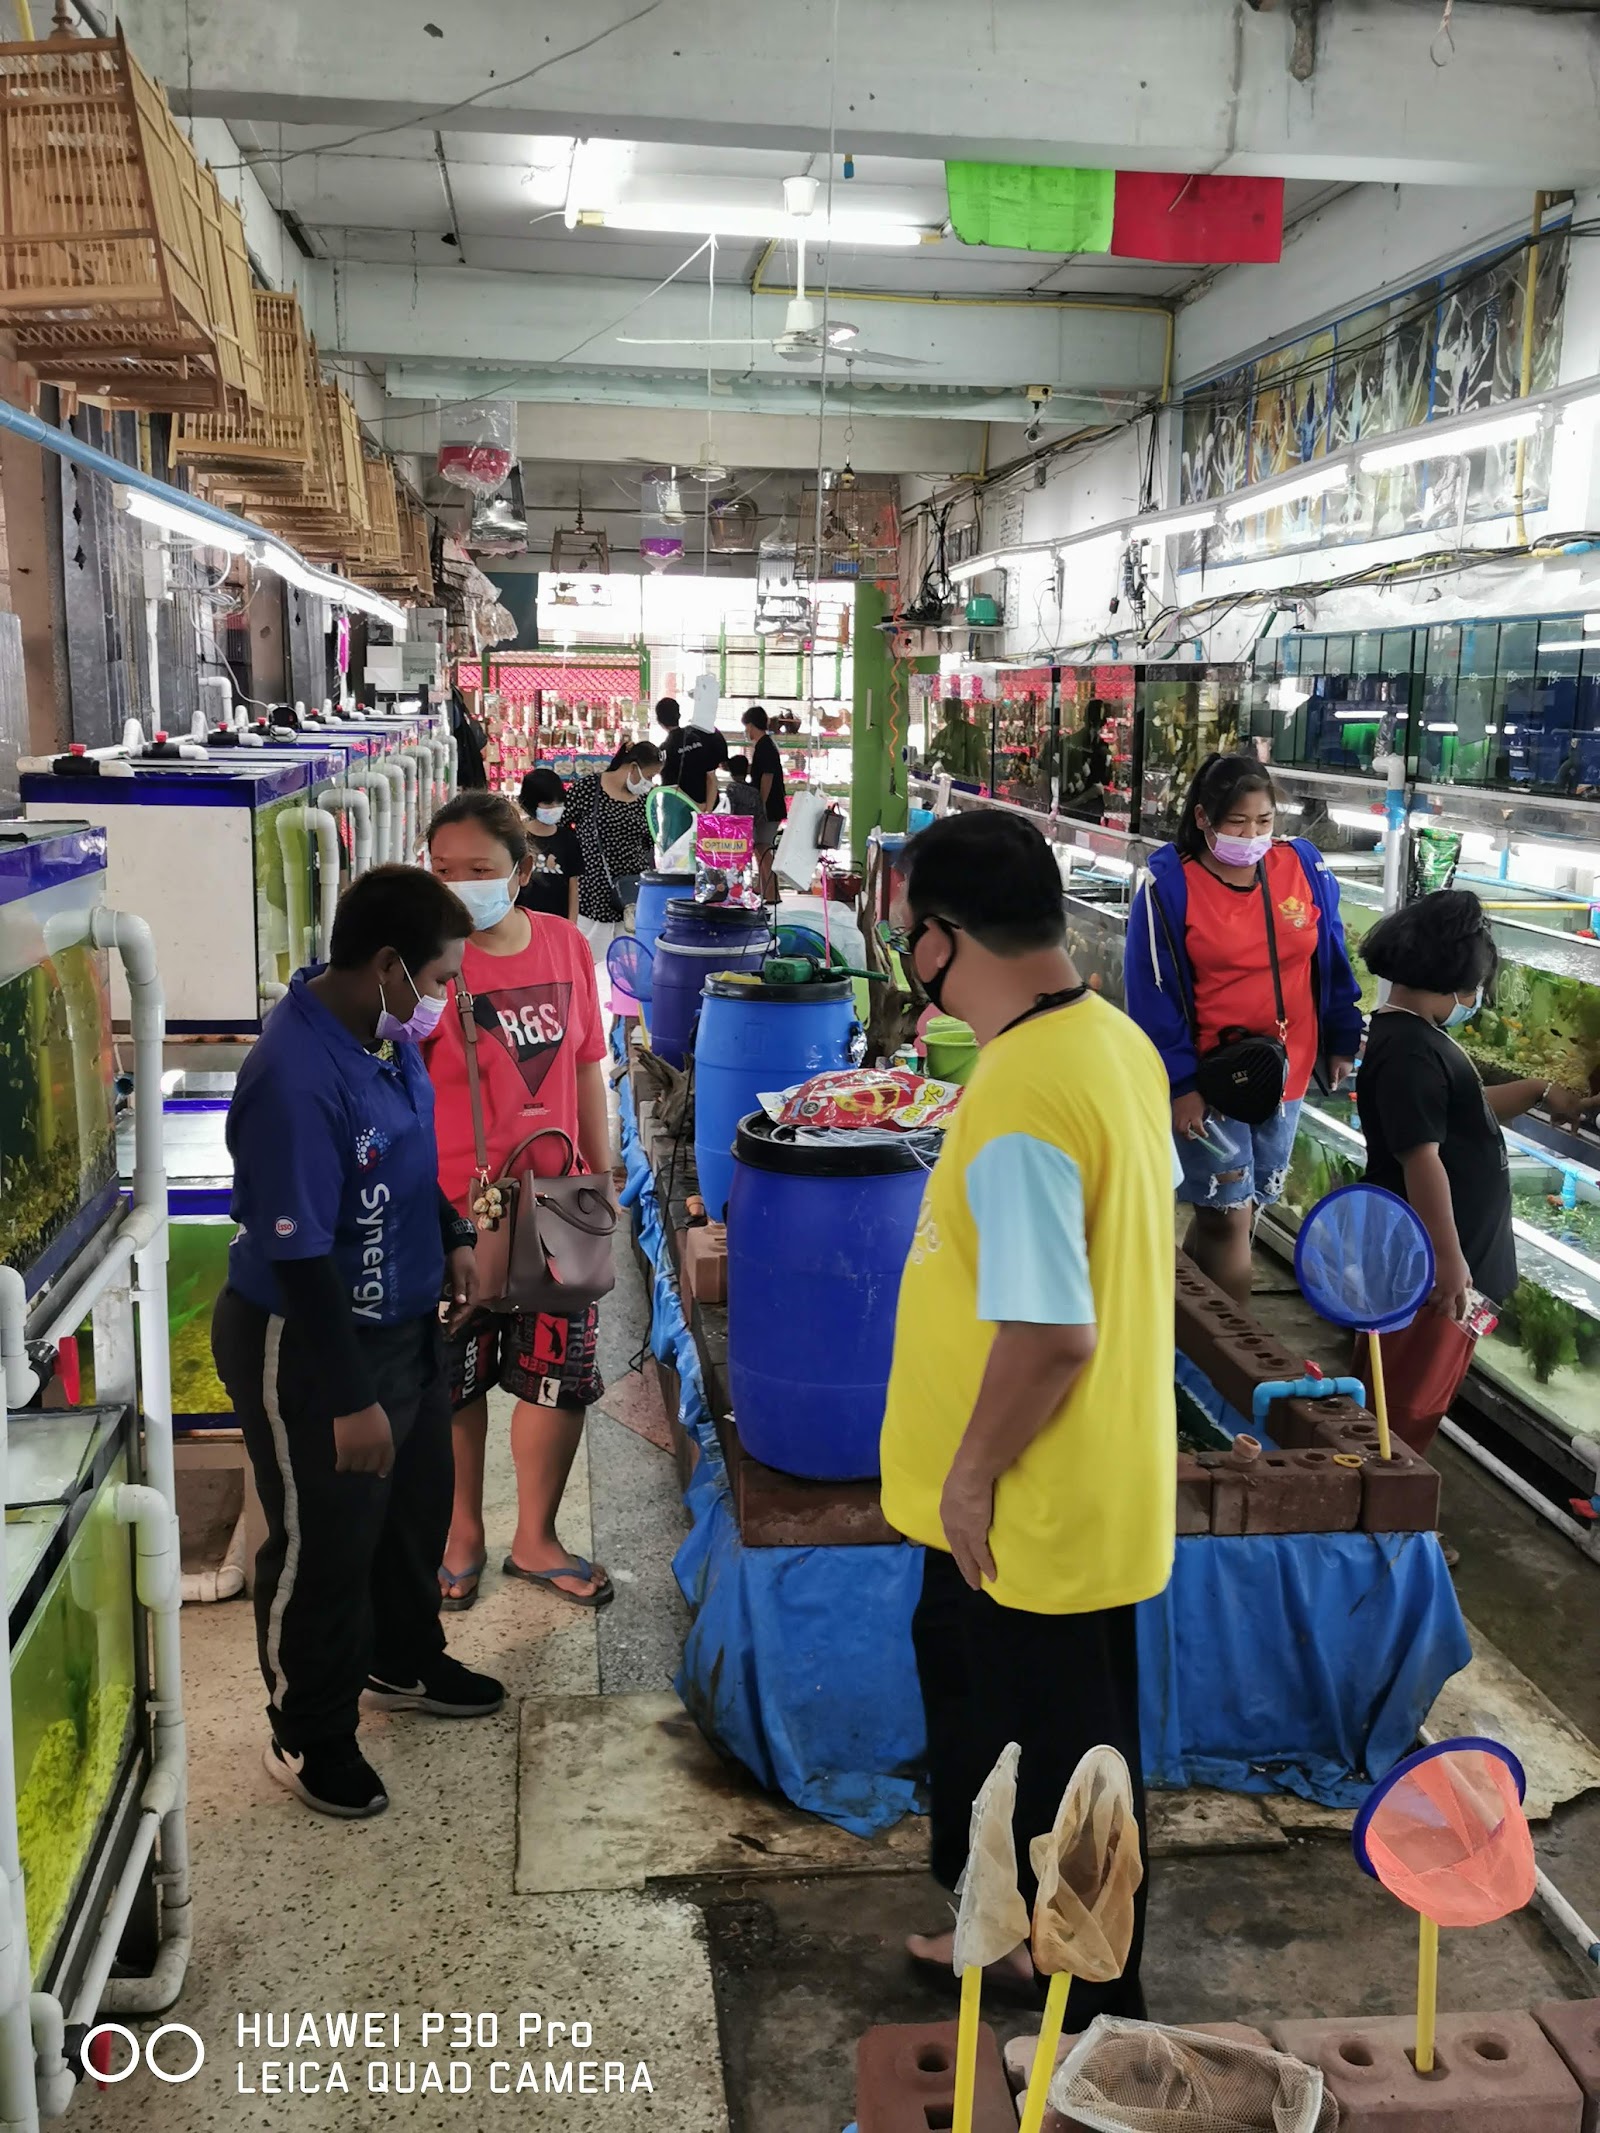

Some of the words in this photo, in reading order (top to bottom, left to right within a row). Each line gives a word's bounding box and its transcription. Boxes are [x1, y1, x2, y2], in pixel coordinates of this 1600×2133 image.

[704, 841, 744, 850] OPTIMUM
[496, 1003, 564, 1048] R&S
[351, 1182, 391, 1320] Synergy
[461, 1336, 479, 1399] TIGER
